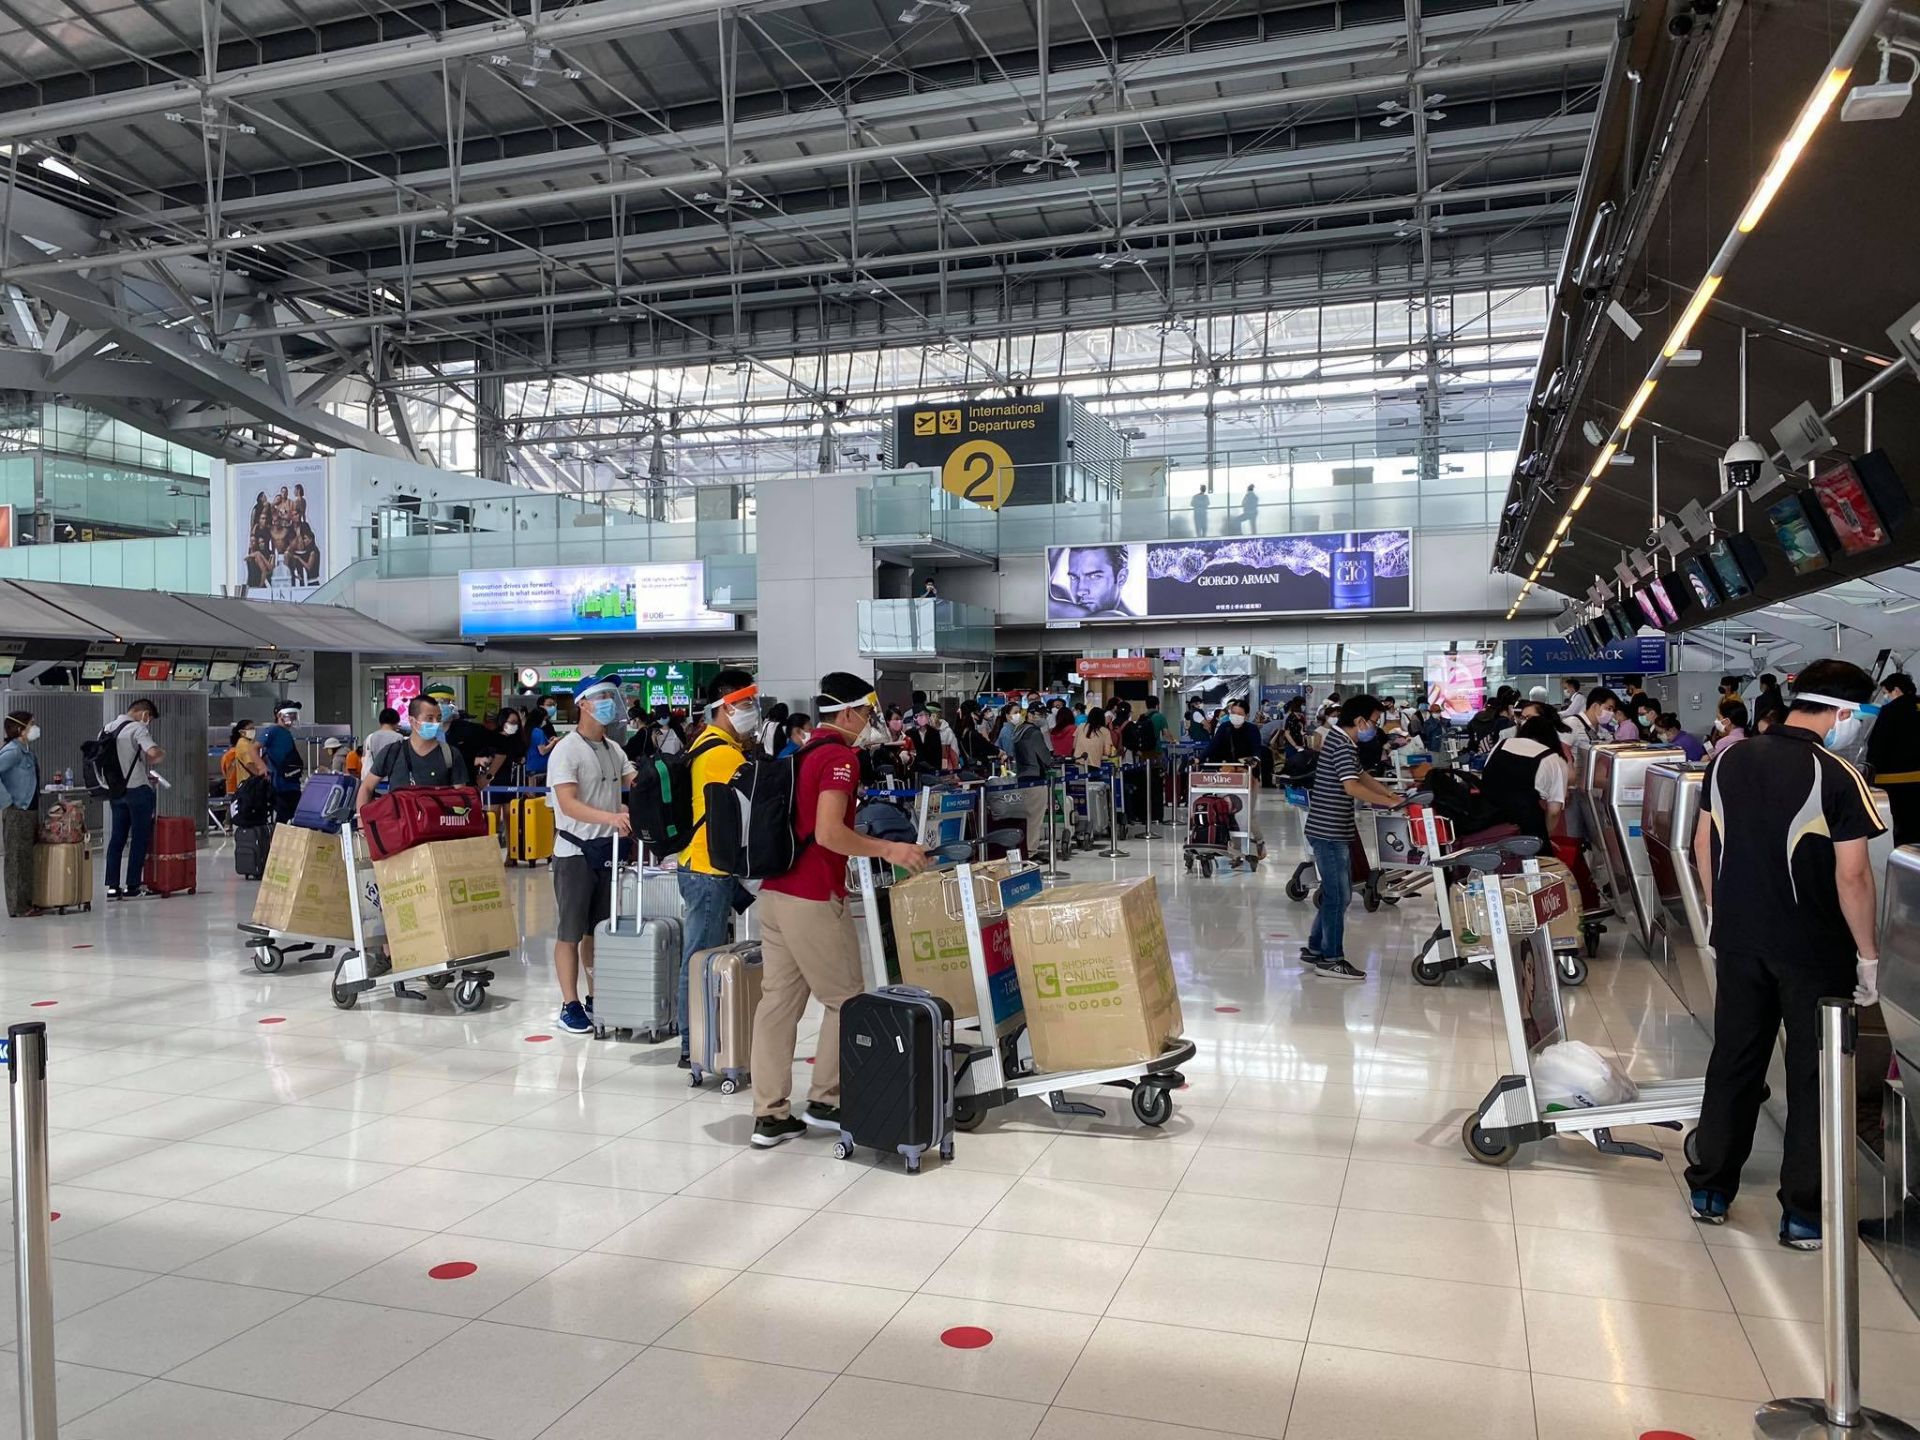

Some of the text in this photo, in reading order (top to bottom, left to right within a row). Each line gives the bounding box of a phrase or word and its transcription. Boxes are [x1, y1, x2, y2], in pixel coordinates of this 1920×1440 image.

[969, 402, 1044, 418] International
[969, 418, 1035, 434] Departures
[963, 452, 994, 502] 2
[1198, 573, 1280, 586] GIORGIO ARMANI
[472, 590, 508, 598] commitment
[1546, 651, 1573, 660] FAST
[440, 815, 466, 826] PUMA
[1062, 956, 1114, 970] SHOPPING
[1064, 967, 1117, 983] ONLINE
